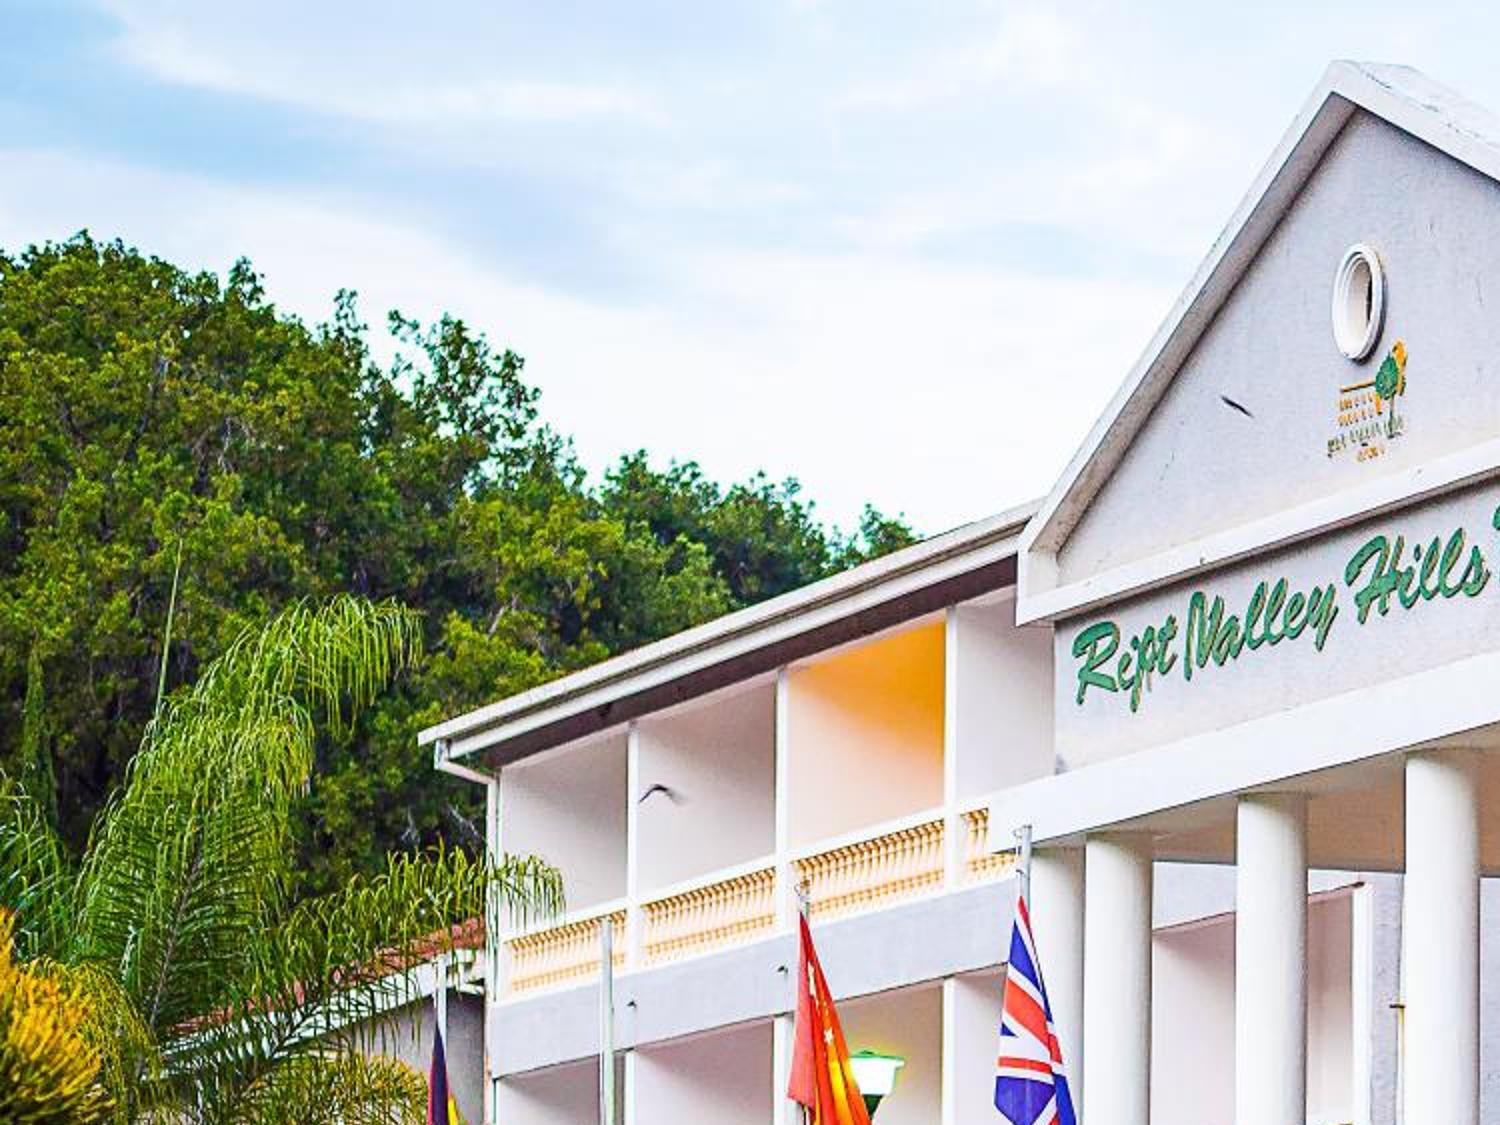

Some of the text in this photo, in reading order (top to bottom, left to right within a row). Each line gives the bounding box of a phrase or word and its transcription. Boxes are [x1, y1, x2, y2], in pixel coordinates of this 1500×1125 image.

[1072, 614, 1178, 713] Rift
[1184, 577, 1339, 681] Valley
[1344, 527, 1490, 625] Hills
